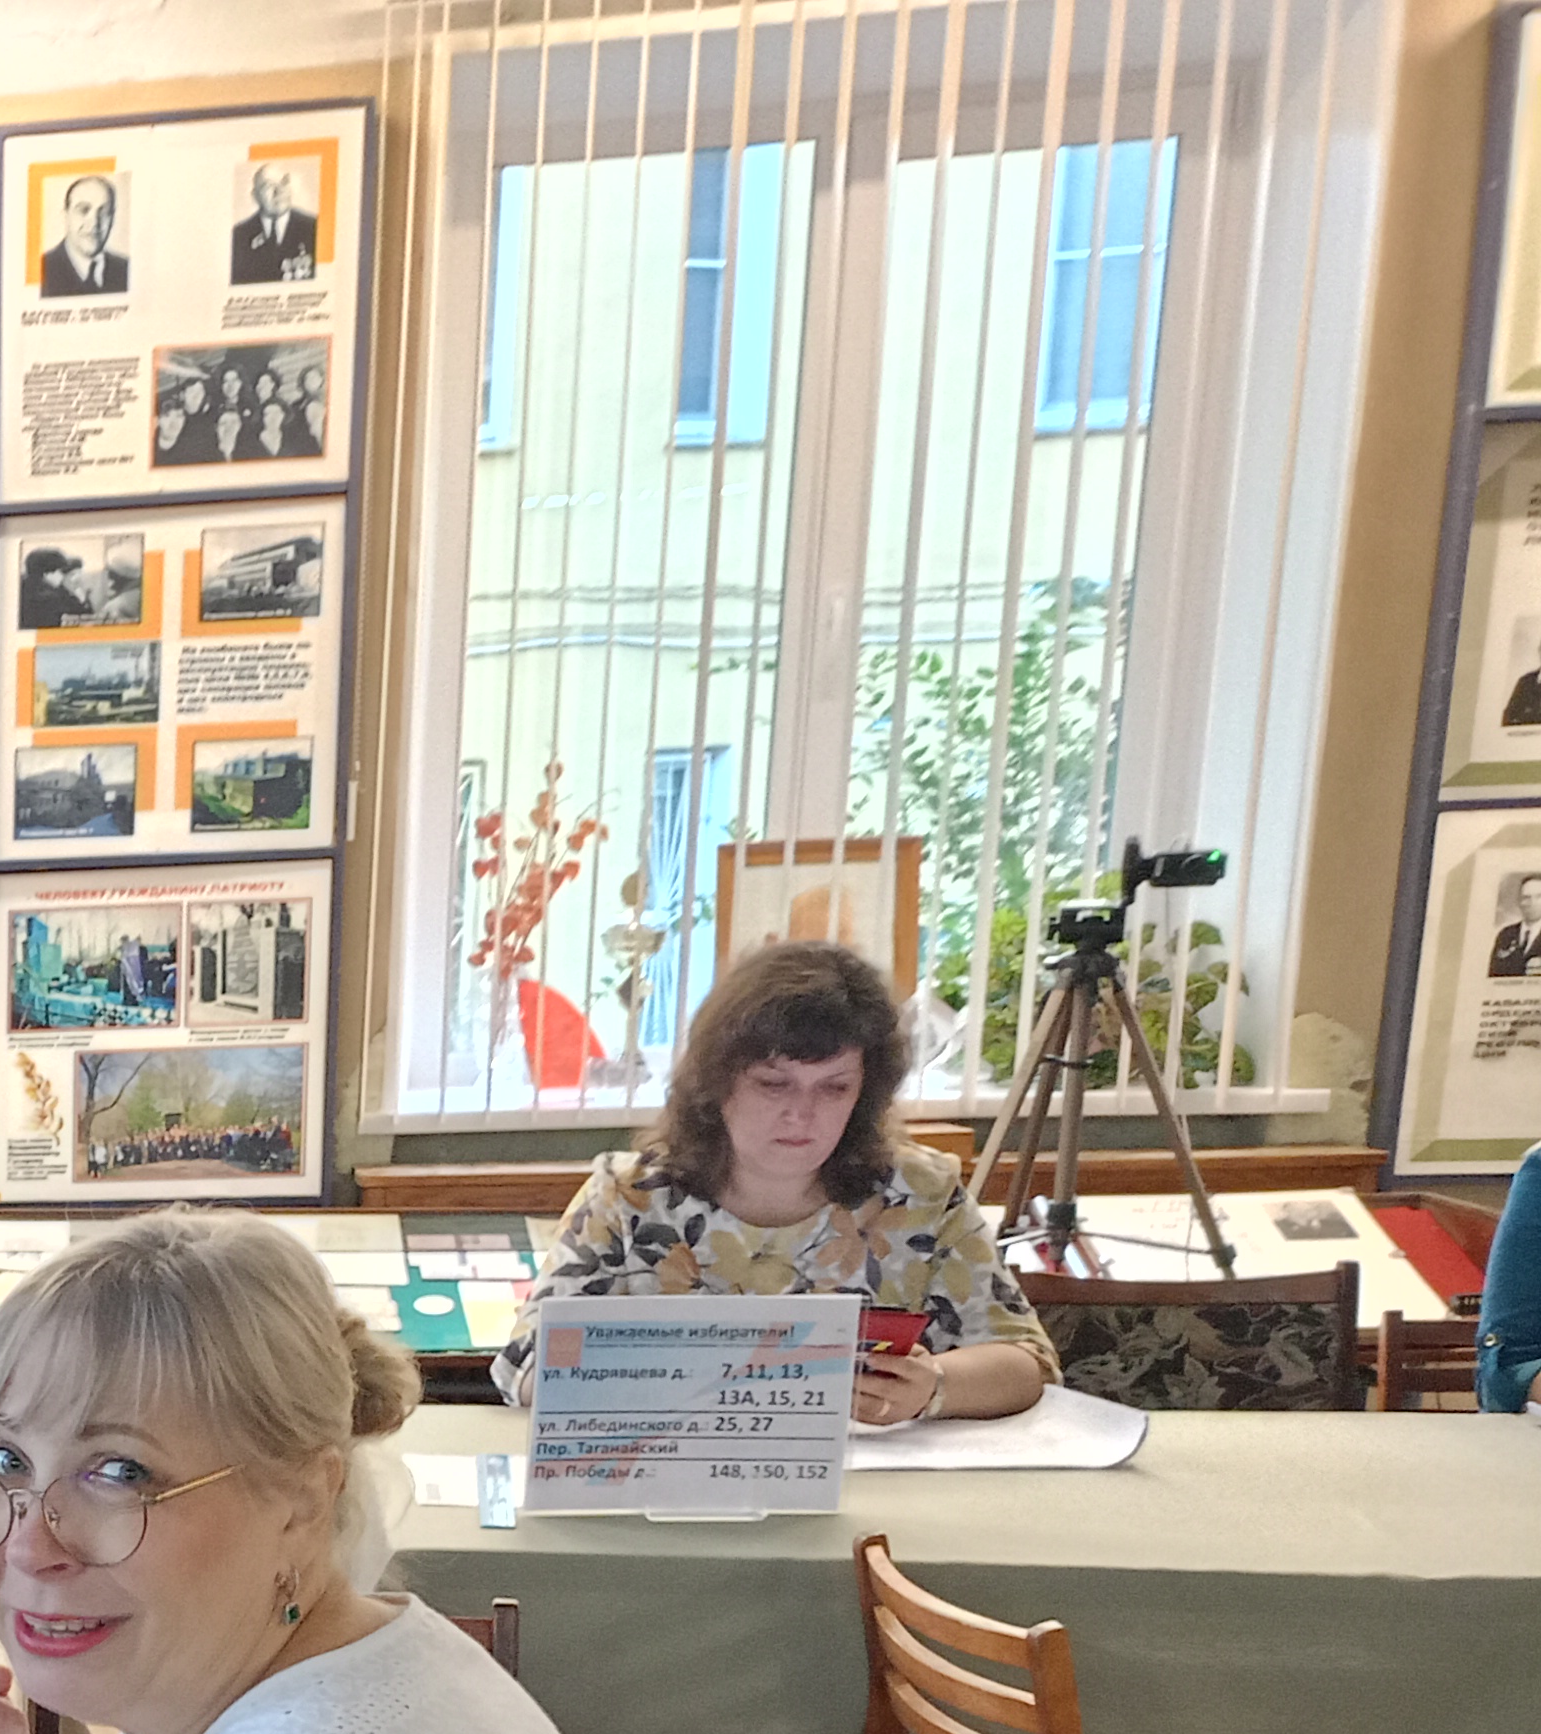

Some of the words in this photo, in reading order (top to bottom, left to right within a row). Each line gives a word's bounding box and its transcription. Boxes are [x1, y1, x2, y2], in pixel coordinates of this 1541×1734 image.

[585, 1325, 682, 1340] Уважаемые
[689, 1324, 795, 1339] избиратели!
[543, 1370, 565, 1382] ул.
[570, 1366, 666, 1379] Кудрявцева
[722, 1364, 737, 1380] 7,
[745, 1364, 773, 1379] 11,
[781, 1364, 809, 1379] 13,
[717, 1390, 759, 1406] 13А,
[767, 1390, 796, 1406] 15,
[803, 1390, 825, 1405] 21
[538, 1423, 559, 1433] ул.
[565, 1418, 682, 1433] Либединского
[714, 1417, 744, 1432] 25,
[750, 1417, 773, 1431] 27
[536, 1442, 571, 1455] Пер.
[577, 1442, 678, 1455] Таганайский
[533, 1466, 560, 1480] Пр.
[565, 1465, 630, 1478] Победы
[709, 1465, 746, 1480] 148,
[752, 1465, 789, 1480] 150,
[796, 1465, 828, 1479] 152
